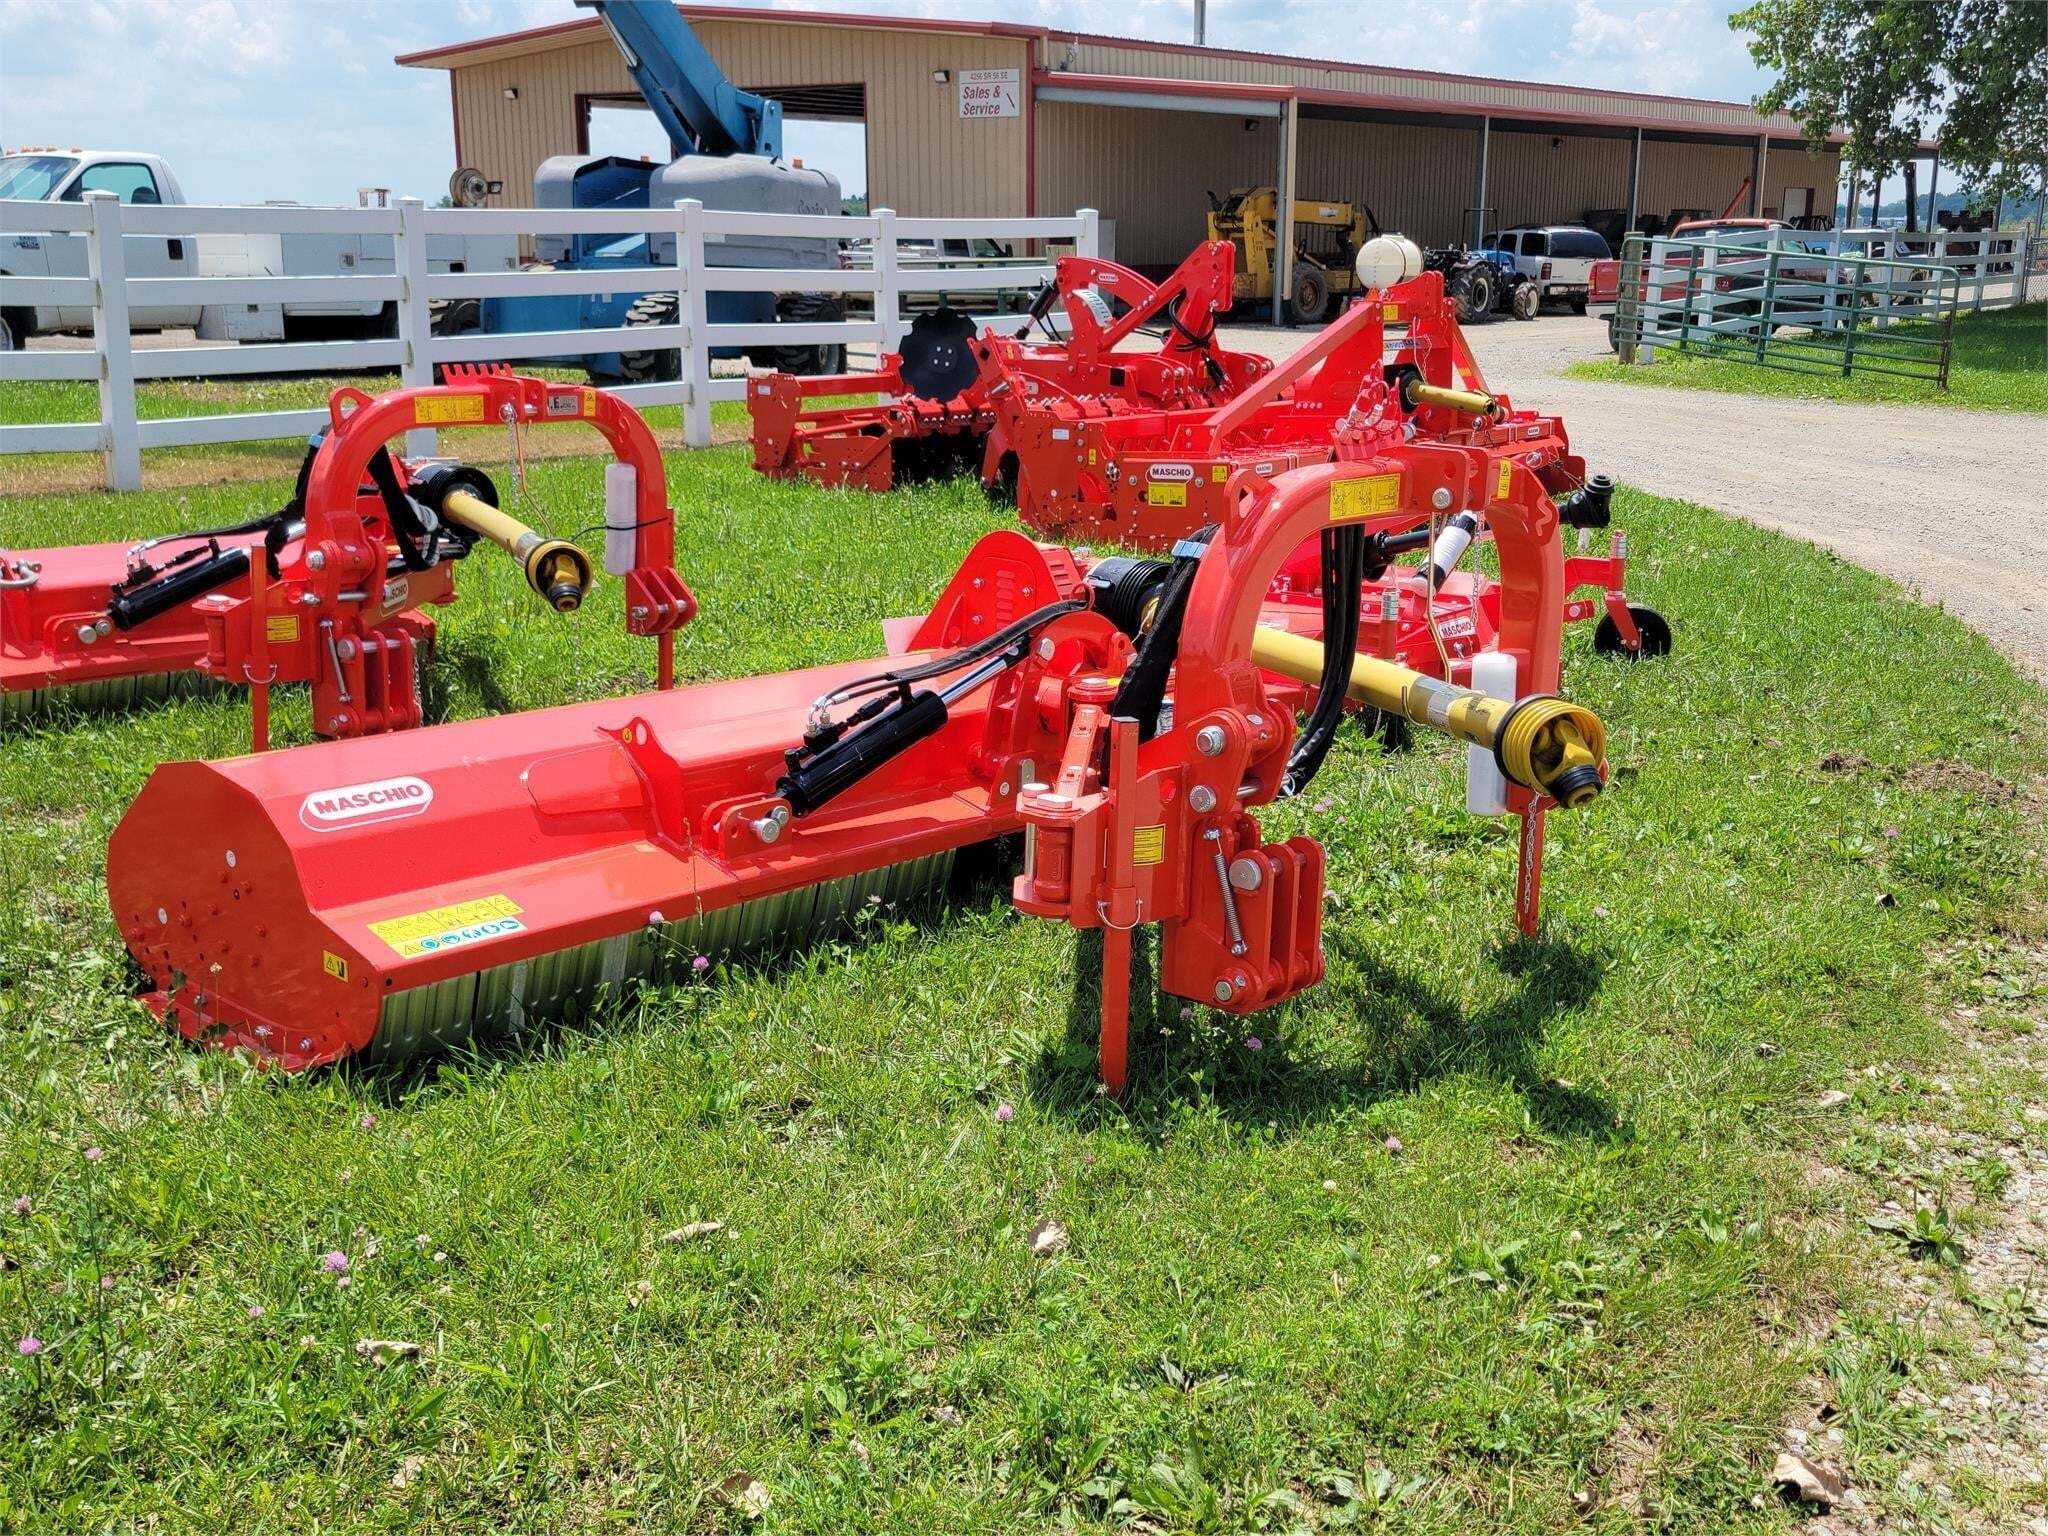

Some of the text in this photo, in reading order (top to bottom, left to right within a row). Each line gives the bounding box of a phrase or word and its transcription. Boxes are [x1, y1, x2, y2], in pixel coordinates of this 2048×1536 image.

[963, 85, 1001, 99] Sales &
[963, 102, 1000, 115] Service
[1152, 468, 1191, 477] MASCHIO
[1441, 621, 1472, 637] MASCHIO
[313, 784, 424, 814] MASCHIO
